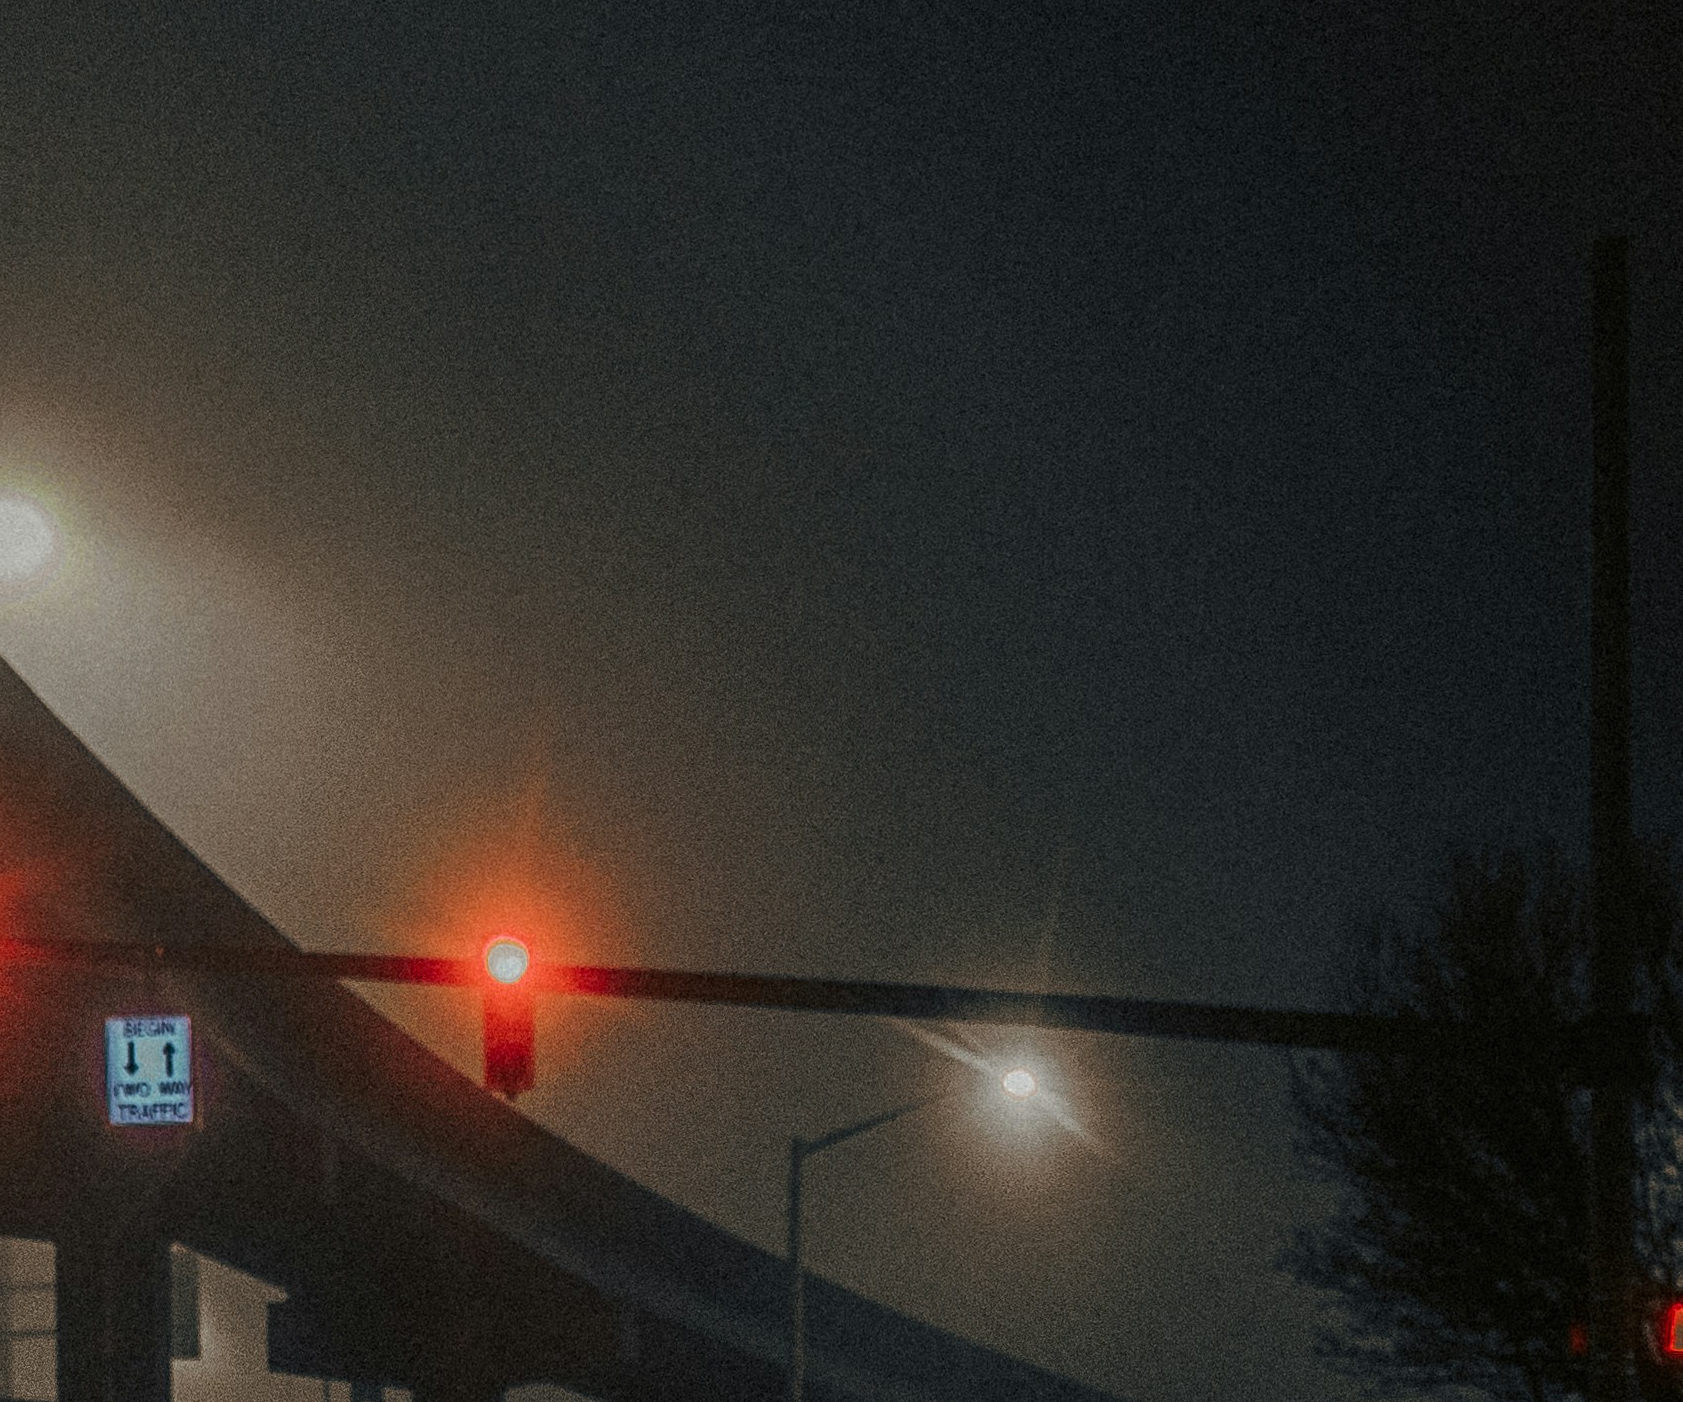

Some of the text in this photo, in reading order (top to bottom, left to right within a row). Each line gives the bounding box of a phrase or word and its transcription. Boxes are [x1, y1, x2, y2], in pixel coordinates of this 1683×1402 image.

[123, 1018, 175, 1037] BEGIN
[113, 1082, 192, 1097] TWO WAY
[118, 1102, 188, 1120] TRAFFIC
